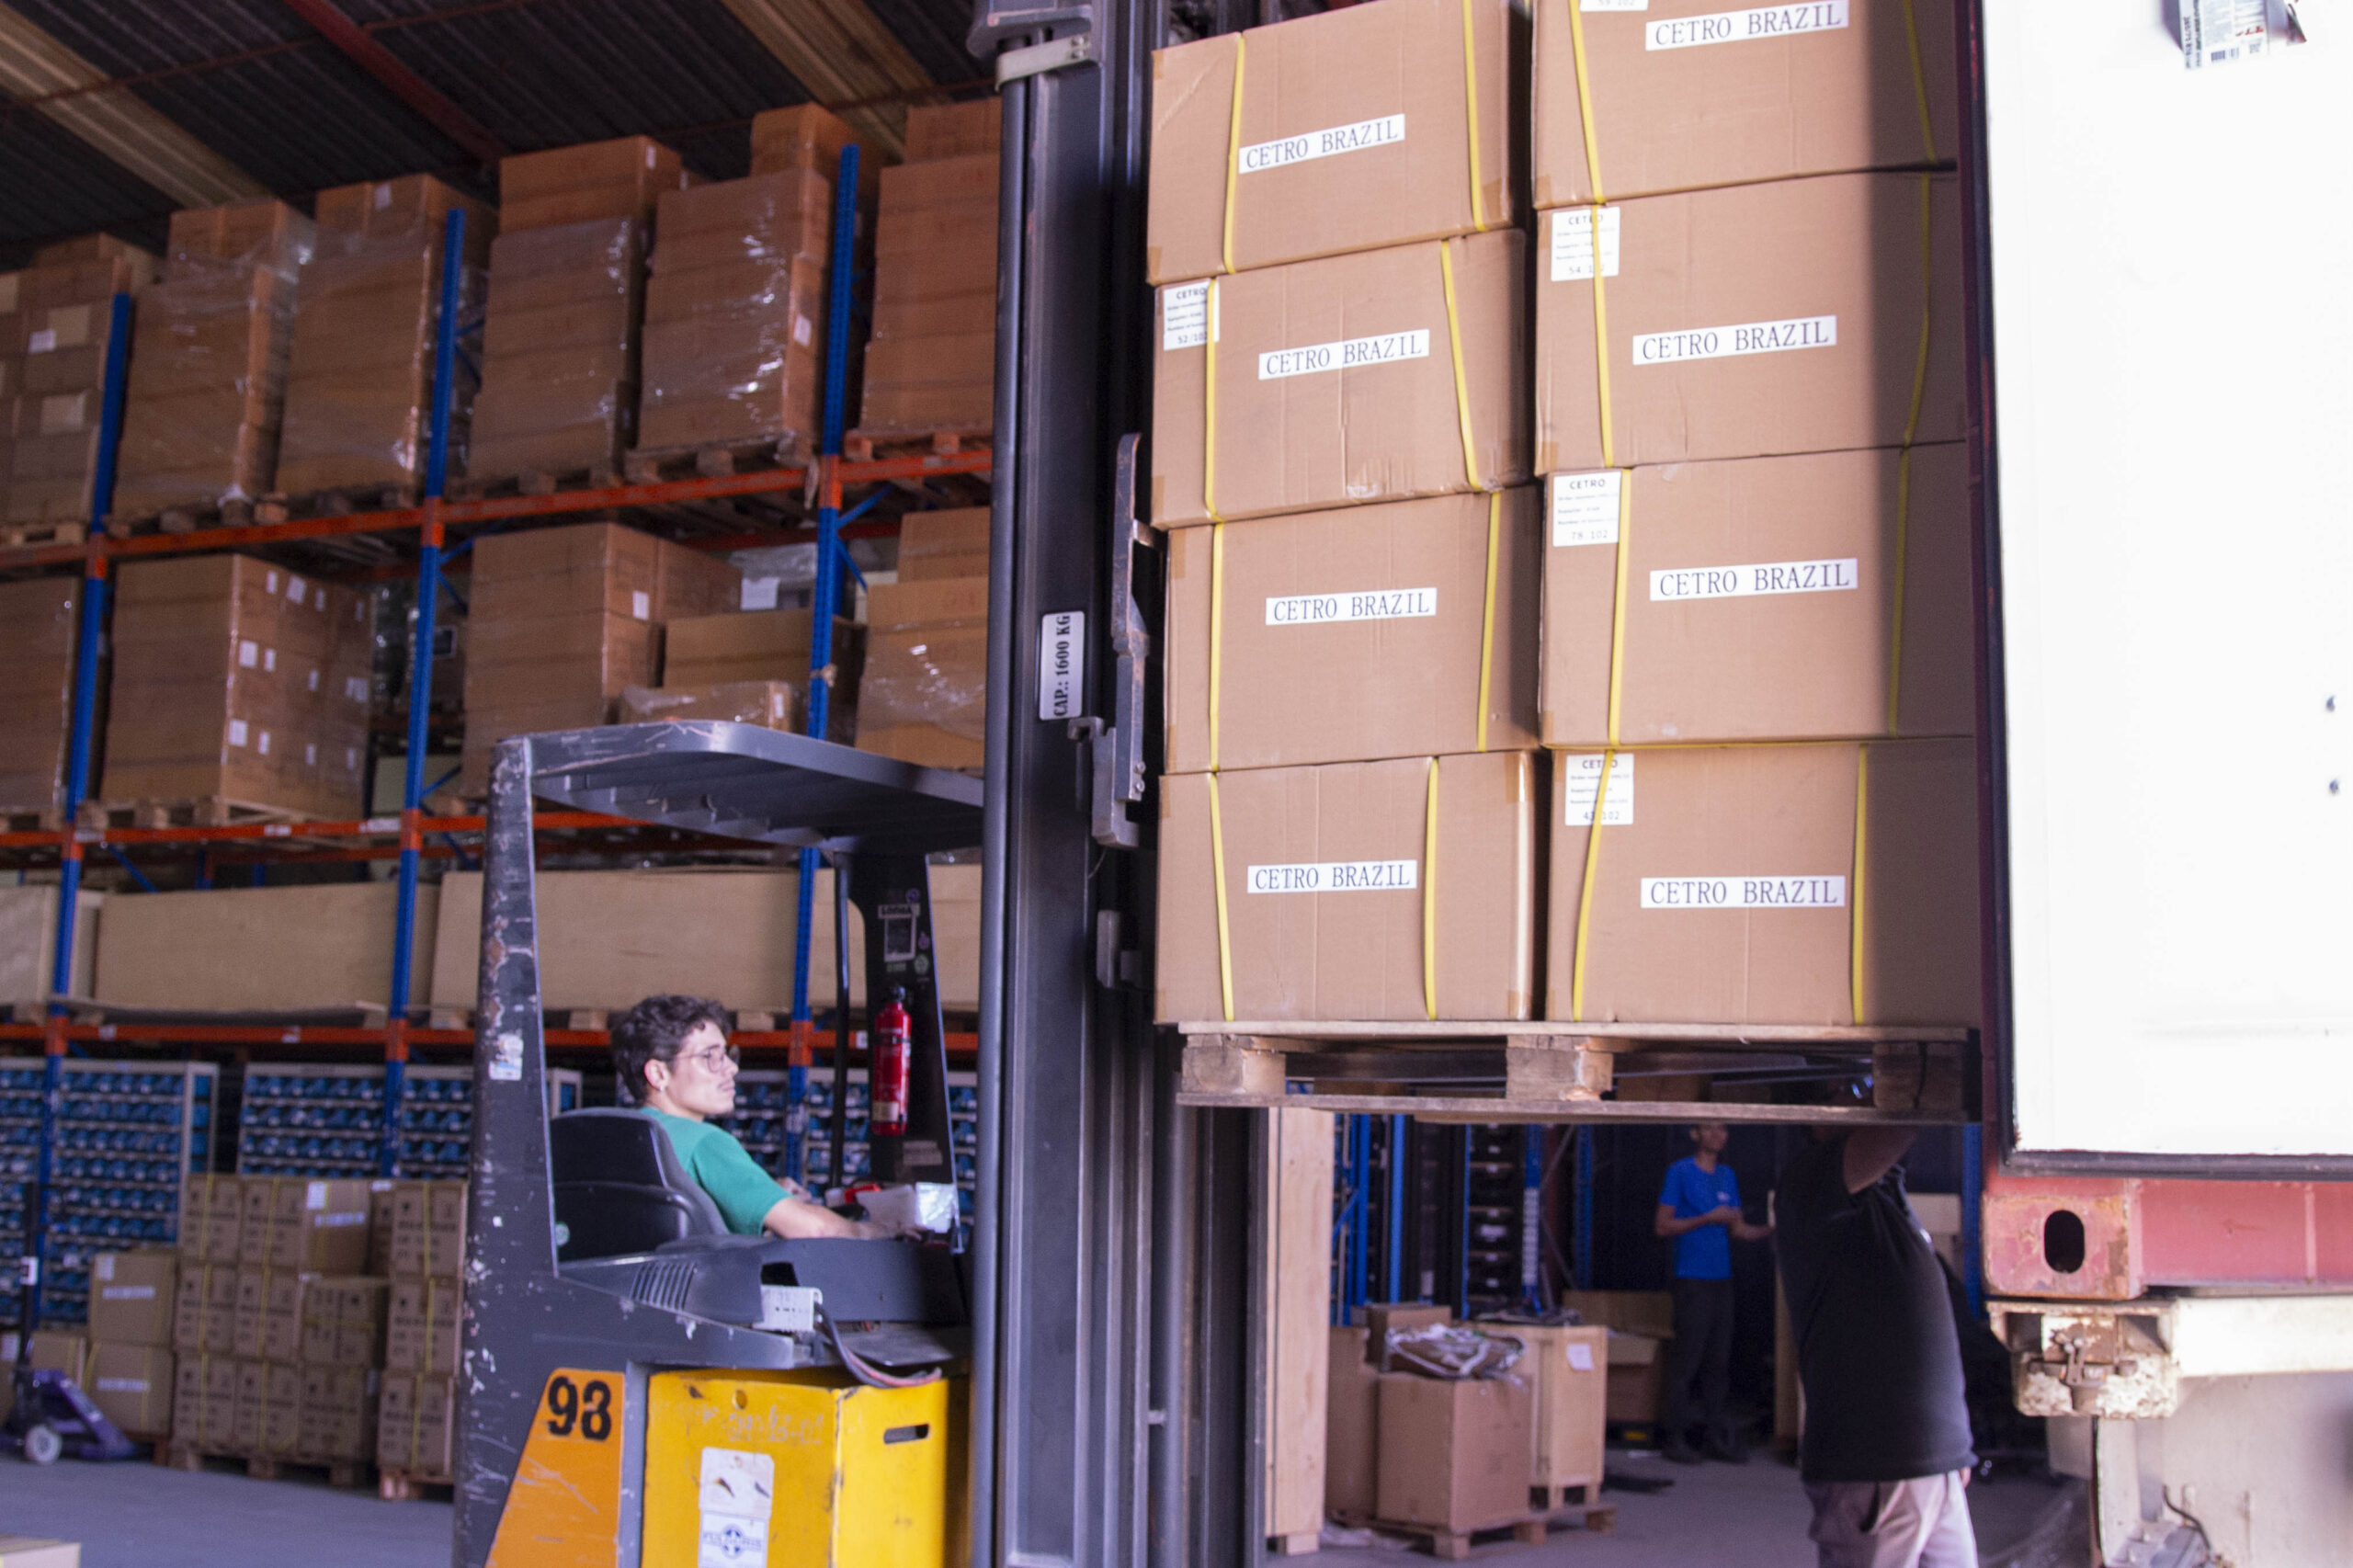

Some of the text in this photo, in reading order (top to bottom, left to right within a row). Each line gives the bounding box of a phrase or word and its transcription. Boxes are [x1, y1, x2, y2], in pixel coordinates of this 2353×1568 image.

[1655, 4, 1842, 46] CETRO BRAZIL
[1245, 120, 1398, 169] CETRO BRAZIL
[1266, 335, 1422, 375] CETRO BRAZIL
[1643, 320, 1829, 359] CETRO BRAZIL
[1569, 479, 1606, 490] CETRO
[1660, 562, 1851, 597] CETRO BRAZIL
[1273, 592, 1430, 621] CETRO BRAZIL
[1056, 615, 1071, 636] KG
[1055, 641, 1070, 676] 1600
[1582, 759, 1619, 769] CETO
[1255, 863, 1411, 890] CETRO BRAZIL
[1651, 880, 1838, 904] CETRO BRAZIL
[547, 1375, 611, 1441] 98
